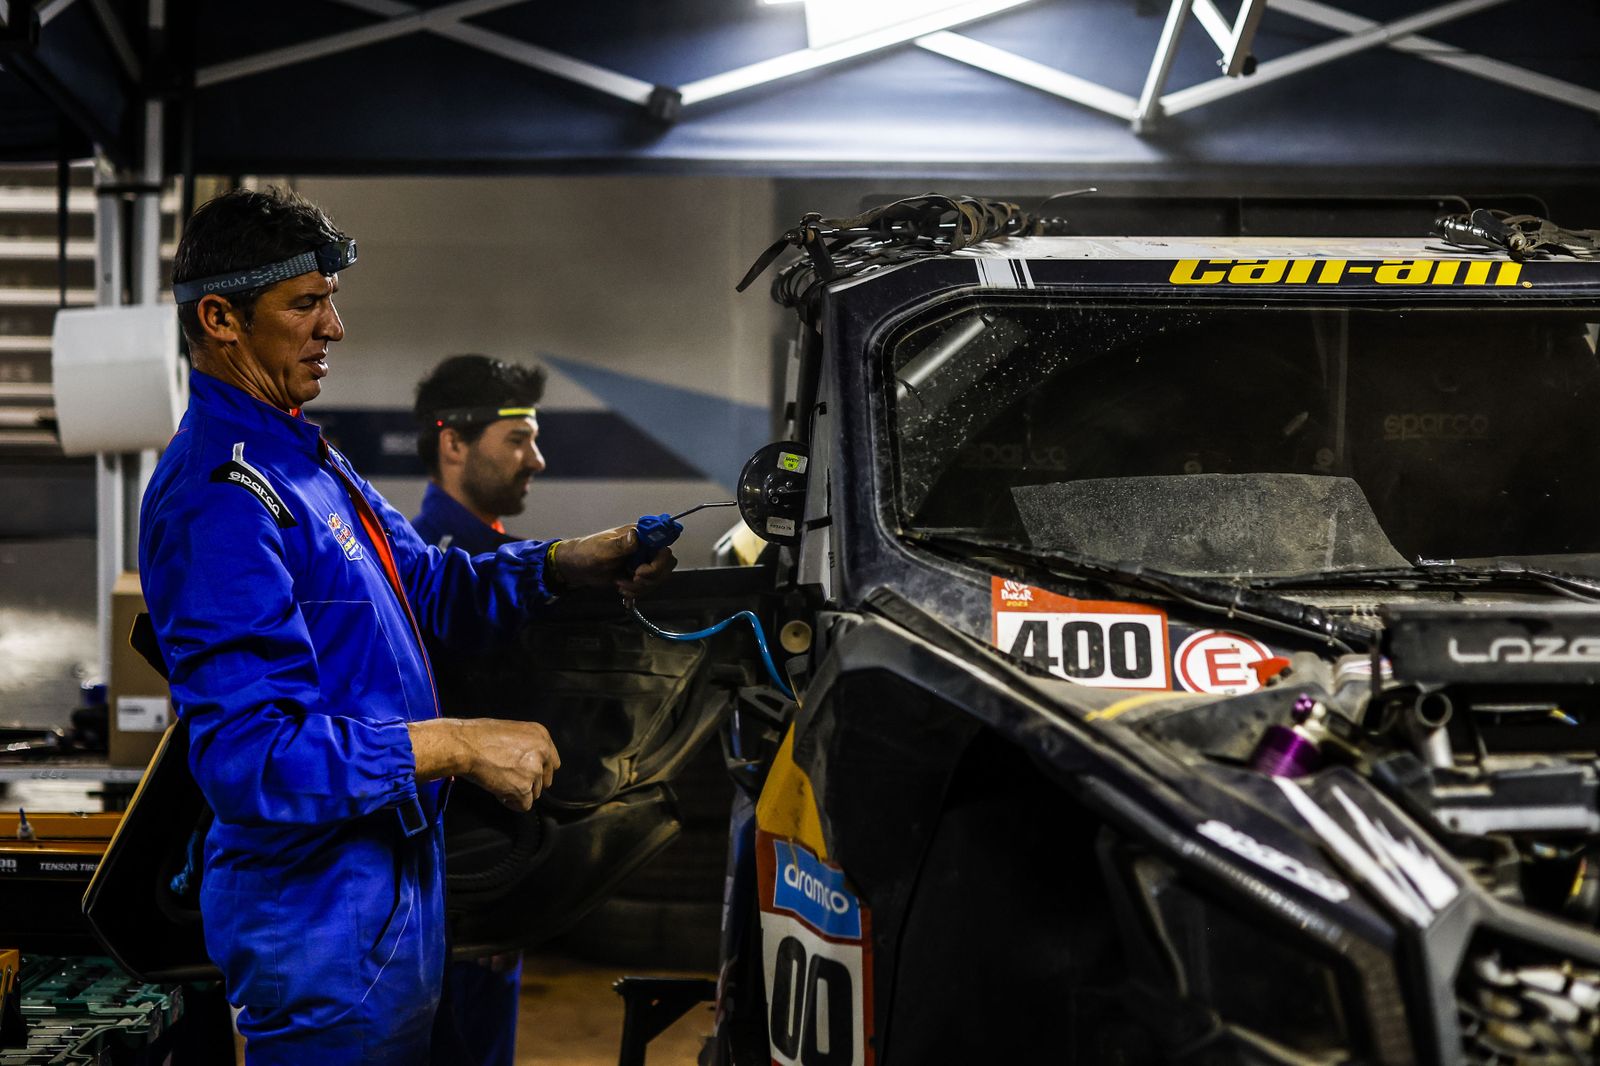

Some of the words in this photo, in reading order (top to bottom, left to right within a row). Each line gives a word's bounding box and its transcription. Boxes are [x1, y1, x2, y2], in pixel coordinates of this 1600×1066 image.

[203, 276, 248, 292] FORCLAZ
[1384, 412, 1488, 440] sparco
[228, 471, 281, 519] sparco
[1001, 589, 1034, 602] DAKAR
[1009, 620, 1153, 680] 400
[1204, 648, 1248, 686] E
[40, 862, 79, 871] TENSOR
[784, 863, 850, 915] aramco
